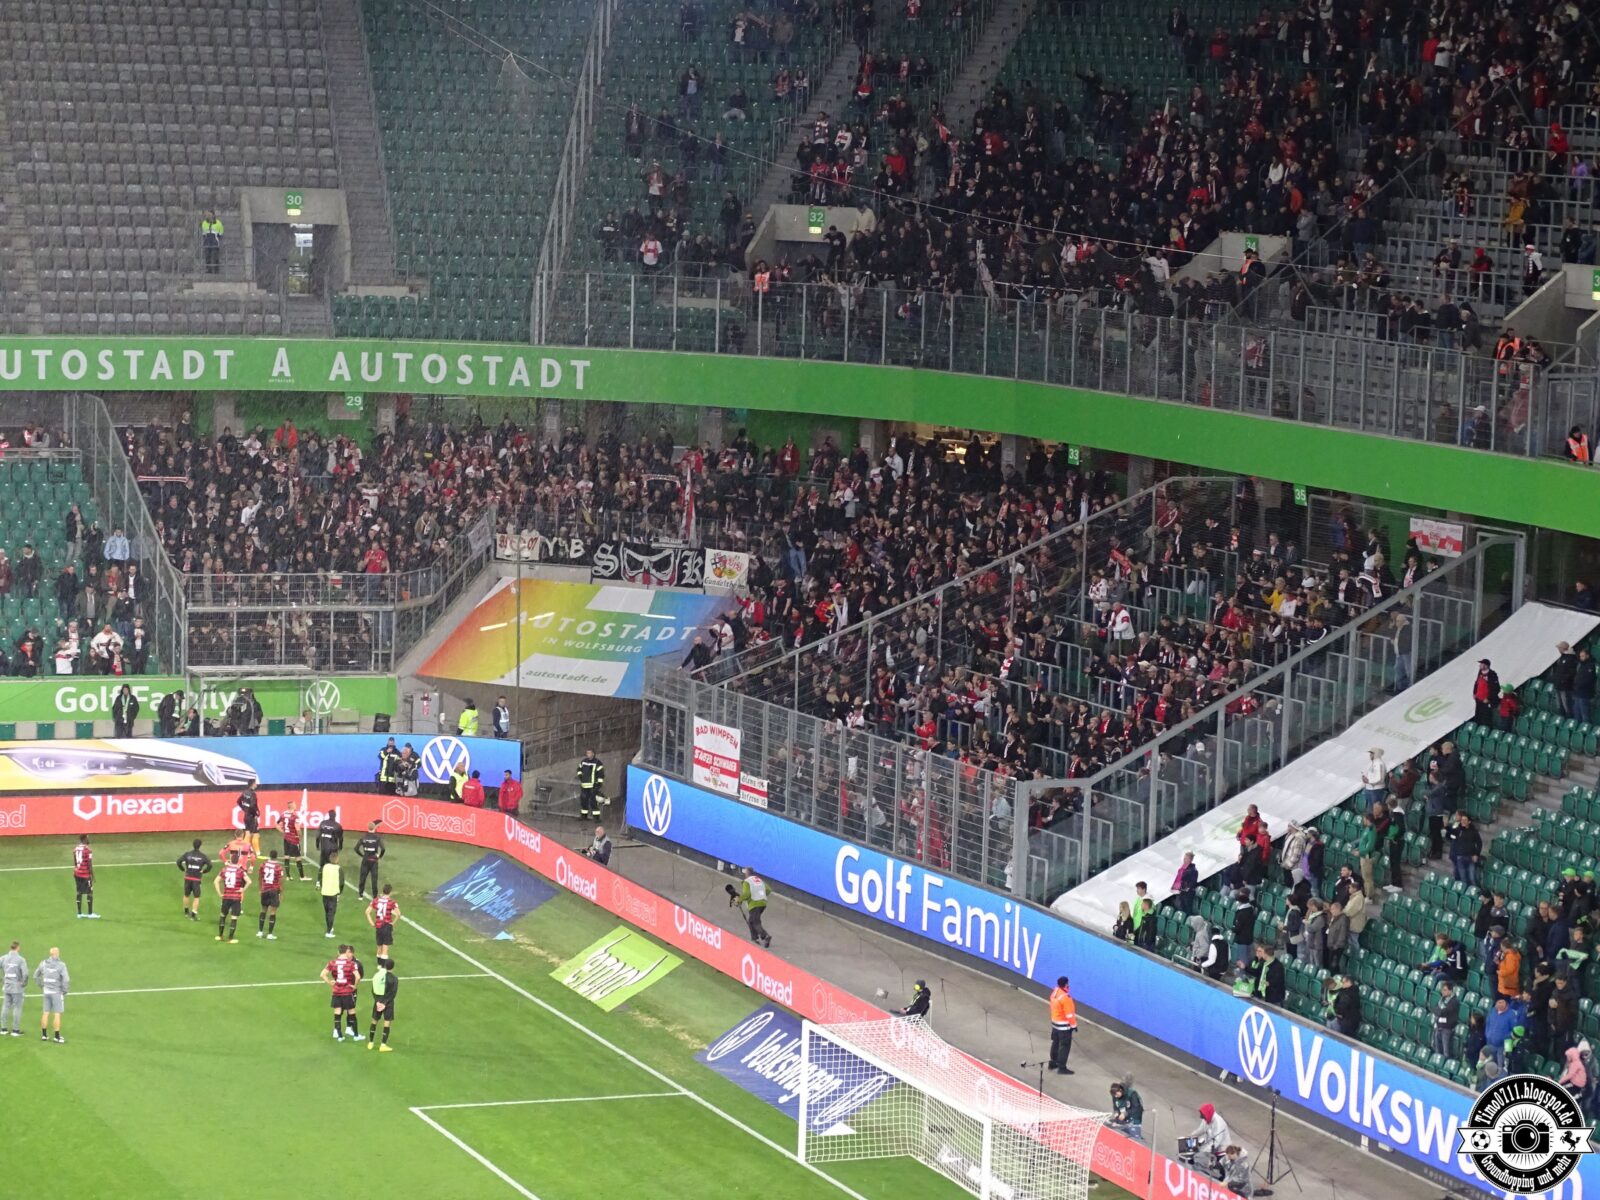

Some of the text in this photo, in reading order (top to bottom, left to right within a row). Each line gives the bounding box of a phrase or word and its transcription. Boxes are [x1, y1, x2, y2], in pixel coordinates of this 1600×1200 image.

[286, 194, 302, 206] 30
[809, 211, 824, 223] 32
[328, 351, 591, 390] AUTOSTADT
[346, 395, 362, 407] 29
[1069, 448, 1080, 460] 33
[1295, 488, 1306, 501] 35
[511, 610, 697, 642] AUTOSTADT
[564, 640, 643, 653] WOLFSBURG
[526, 669, 609, 684] autostadt.de
[695, 725, 709, 737] BAD
[106, 794, 184, 816] hexad
[264, 804, 342, 829] hxad
[413, 805, 476, 837] hexad
[515, 816, 542, 853] hexad
[567, 863, 598, 901] hexad
[625, 886, 658, 927] hexad
[835, 845, 1042, 980] Golf Family
[687, 910, 722, 950] hexad
[756, 963, 793, 1007] hexad
[1291, 1025, 1583, 1200] Volkswn
